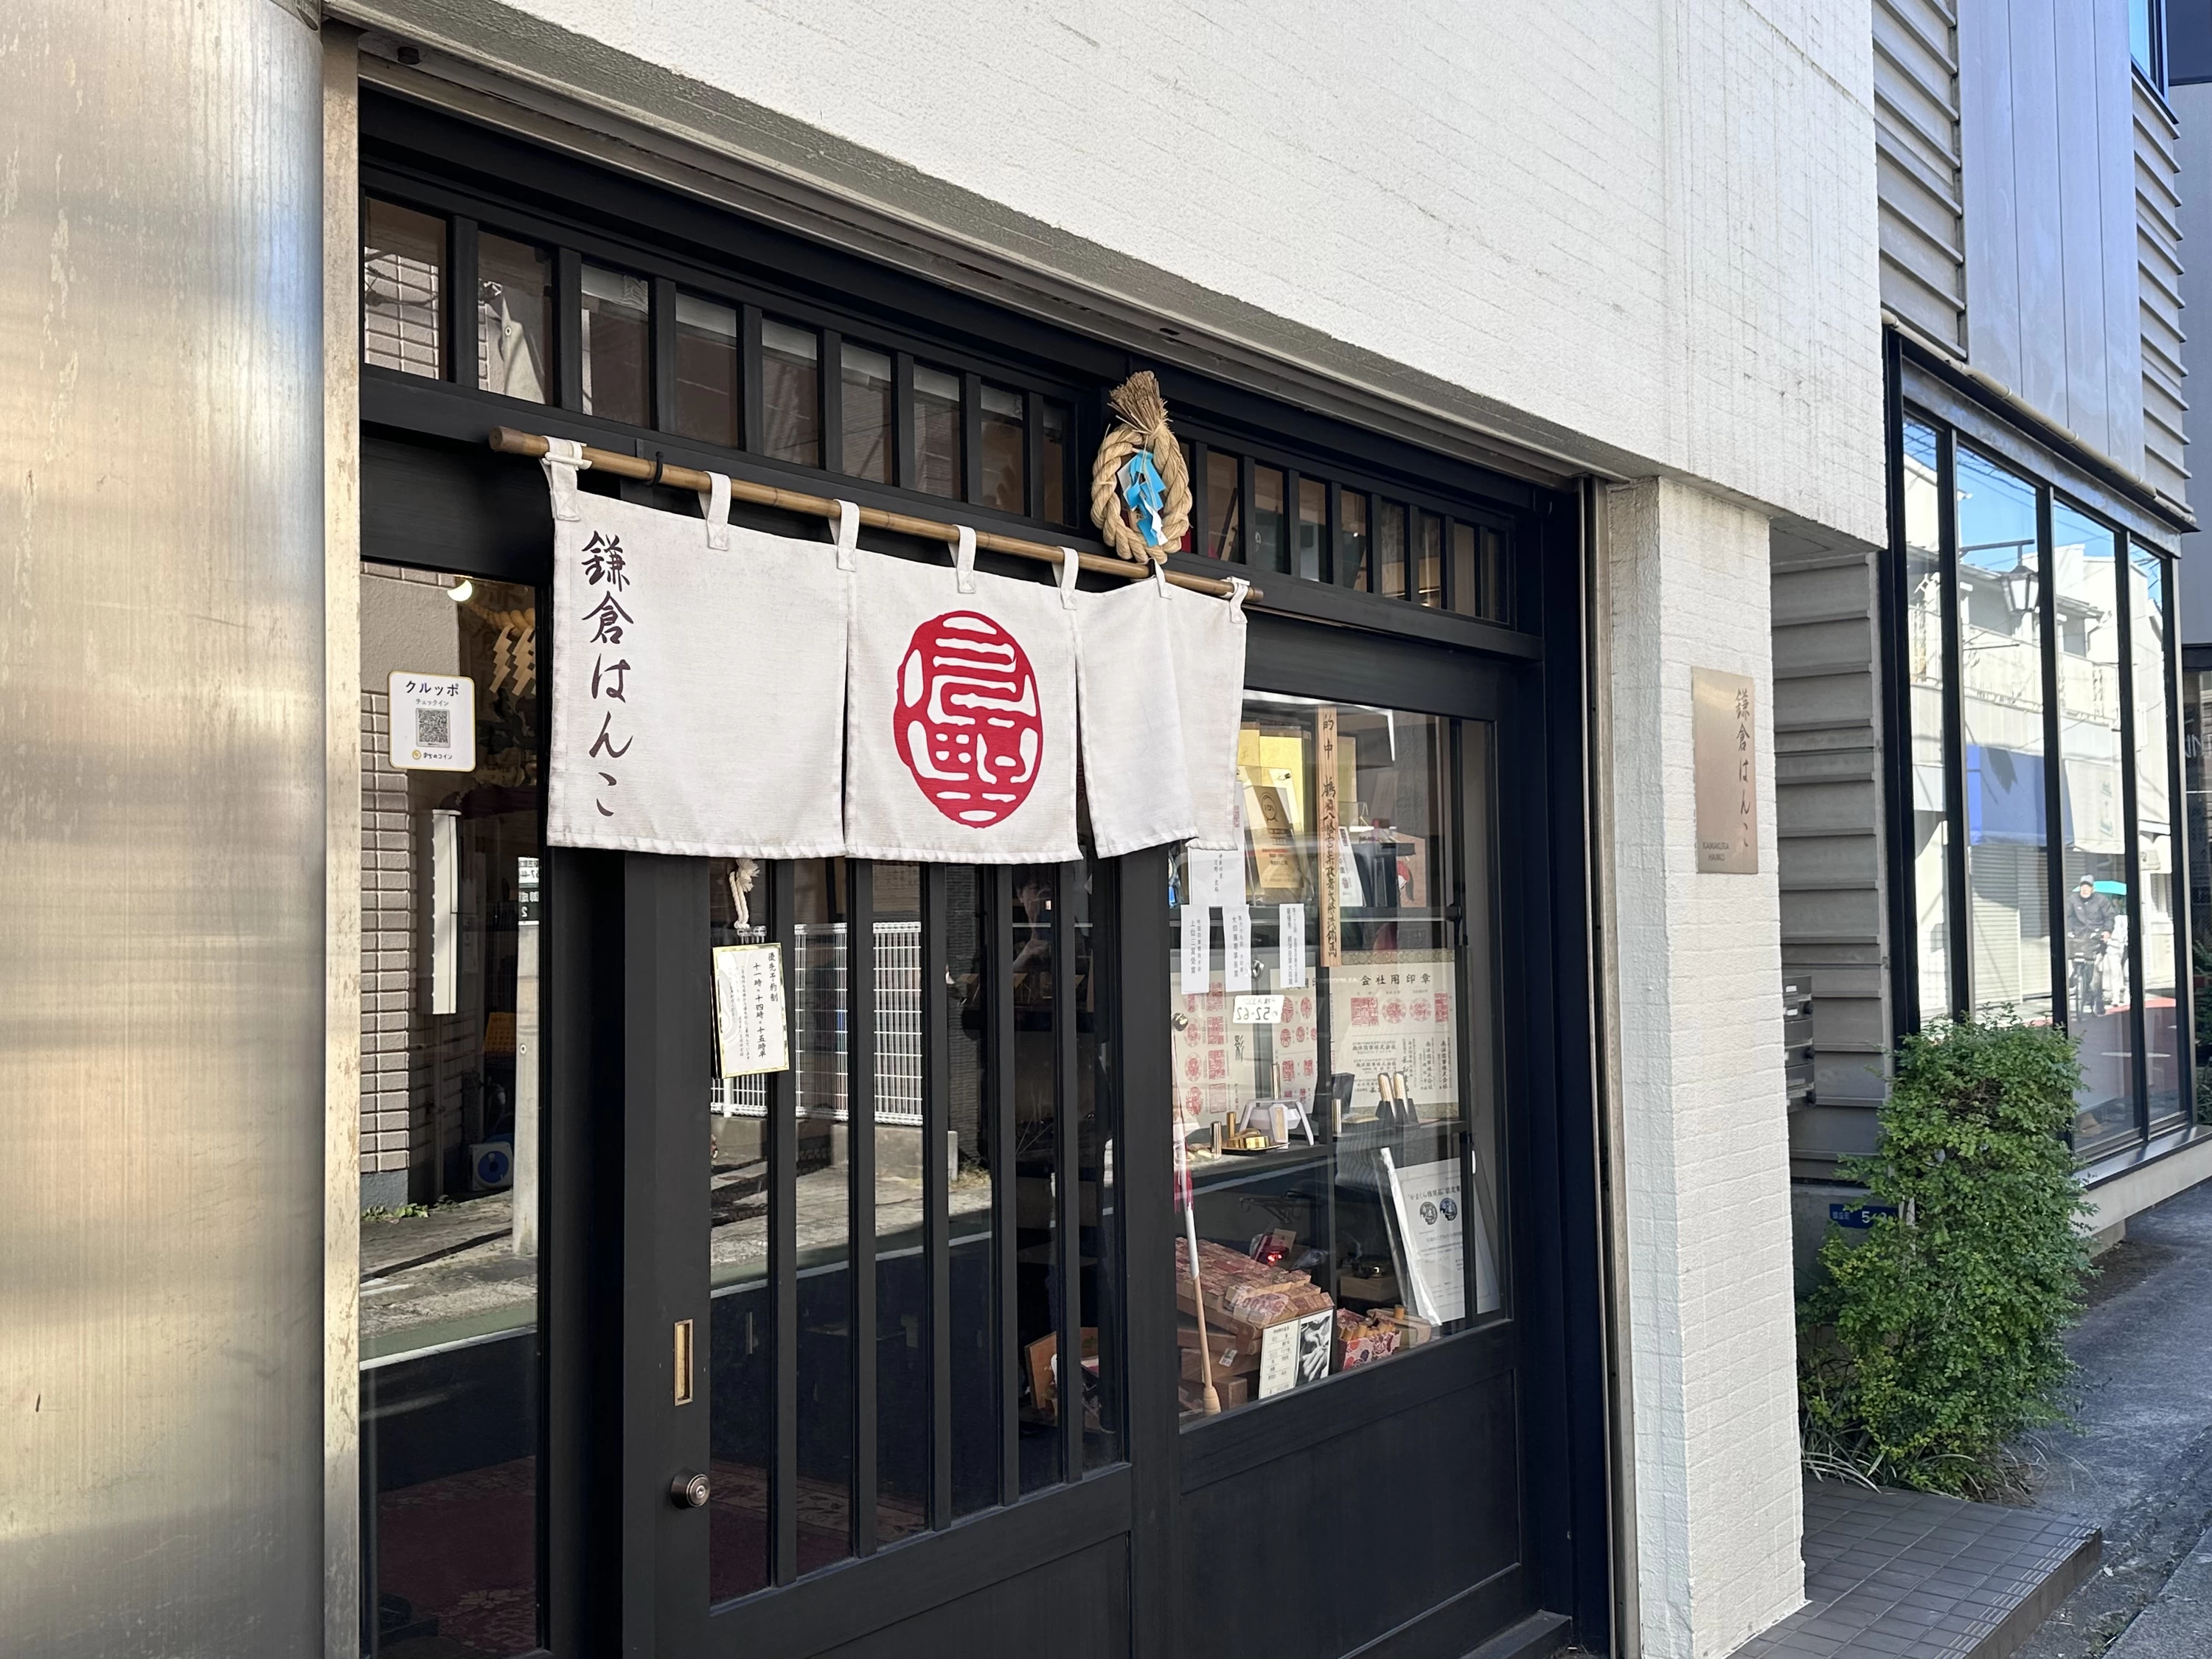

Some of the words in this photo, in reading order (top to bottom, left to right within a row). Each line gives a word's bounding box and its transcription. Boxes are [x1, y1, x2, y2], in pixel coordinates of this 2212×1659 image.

[581, 529, 634, 817] 鎌倉はんこ
[405, 680, 459, 697] クルッポ
[415, 698, 449, 706] チェックイン
[1735, 688, 1750, 847] 鎌倉はんこ
[1360, 973, 1431, 987] 会社用印章
